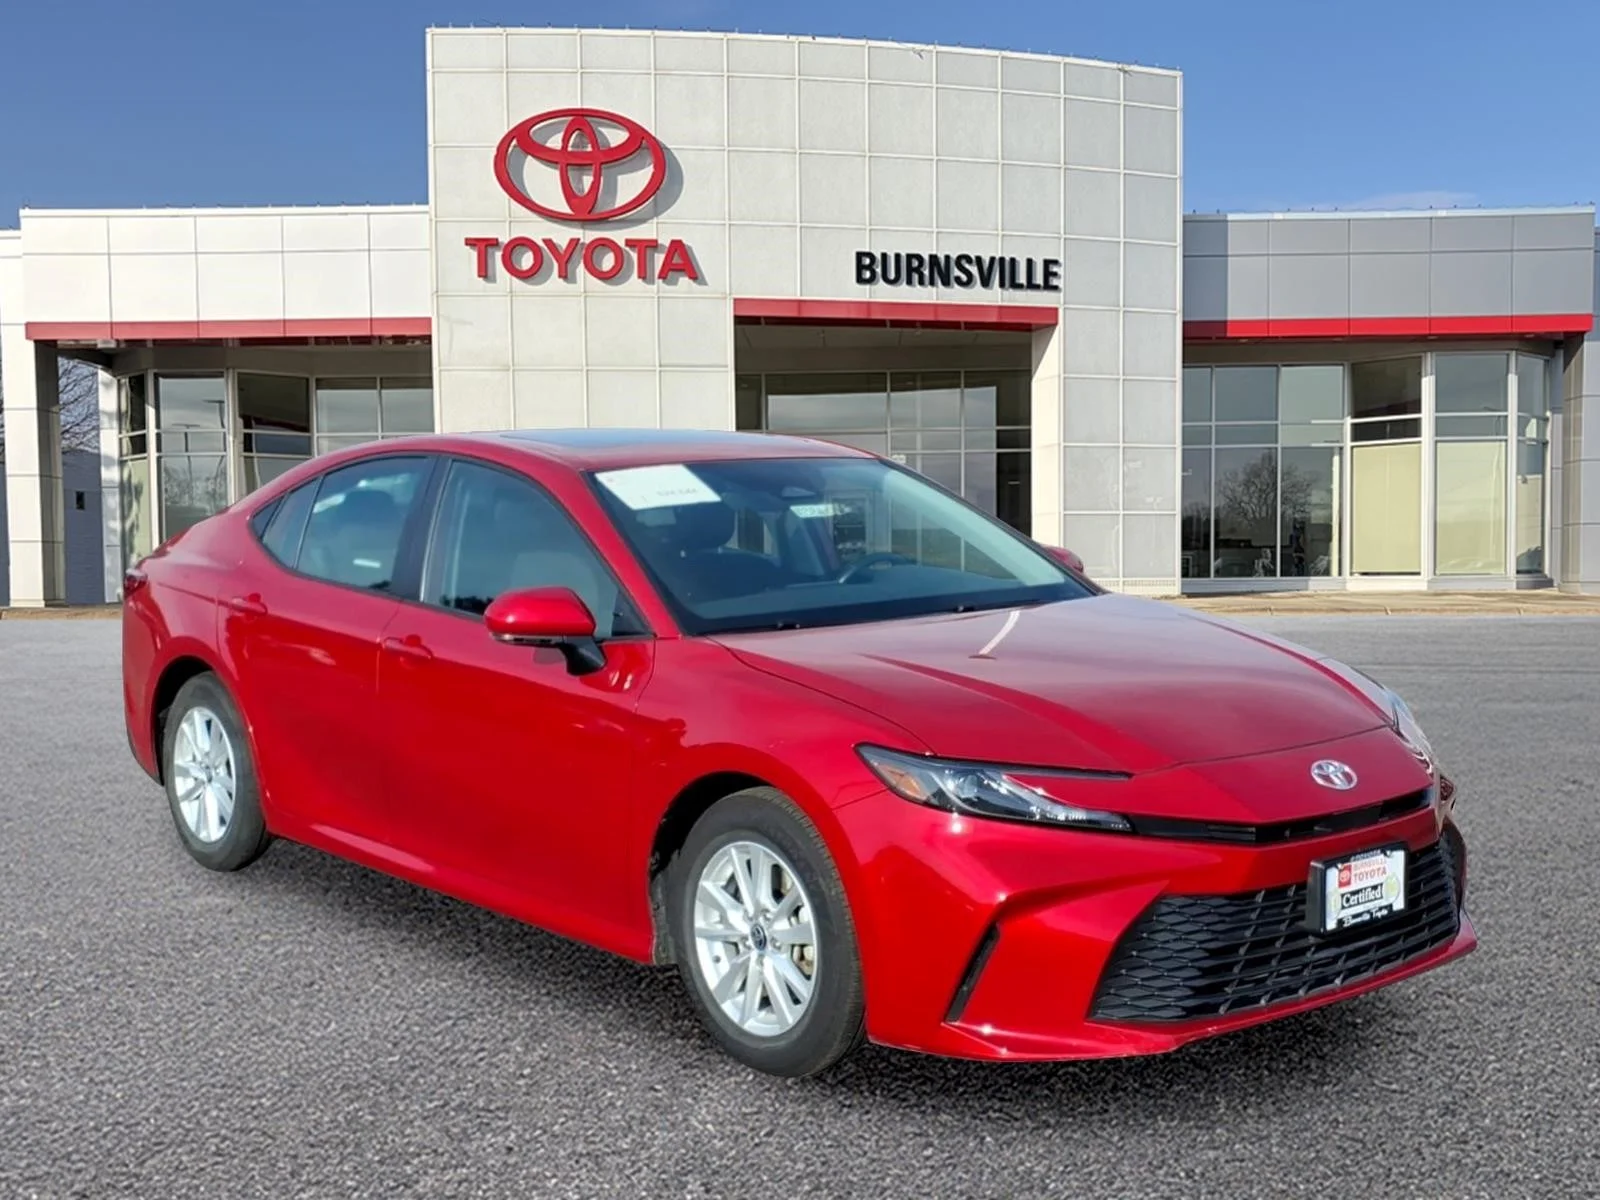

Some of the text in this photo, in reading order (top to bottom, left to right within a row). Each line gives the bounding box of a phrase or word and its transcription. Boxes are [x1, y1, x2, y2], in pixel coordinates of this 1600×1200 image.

[466, 238, 698, 283] TOYOTA
[855, 250, 1062, 291] BURNSVILLE
[1354, 866, 1387, 882] TOYOTA
[1342, 885, 1381, 907] Certified
